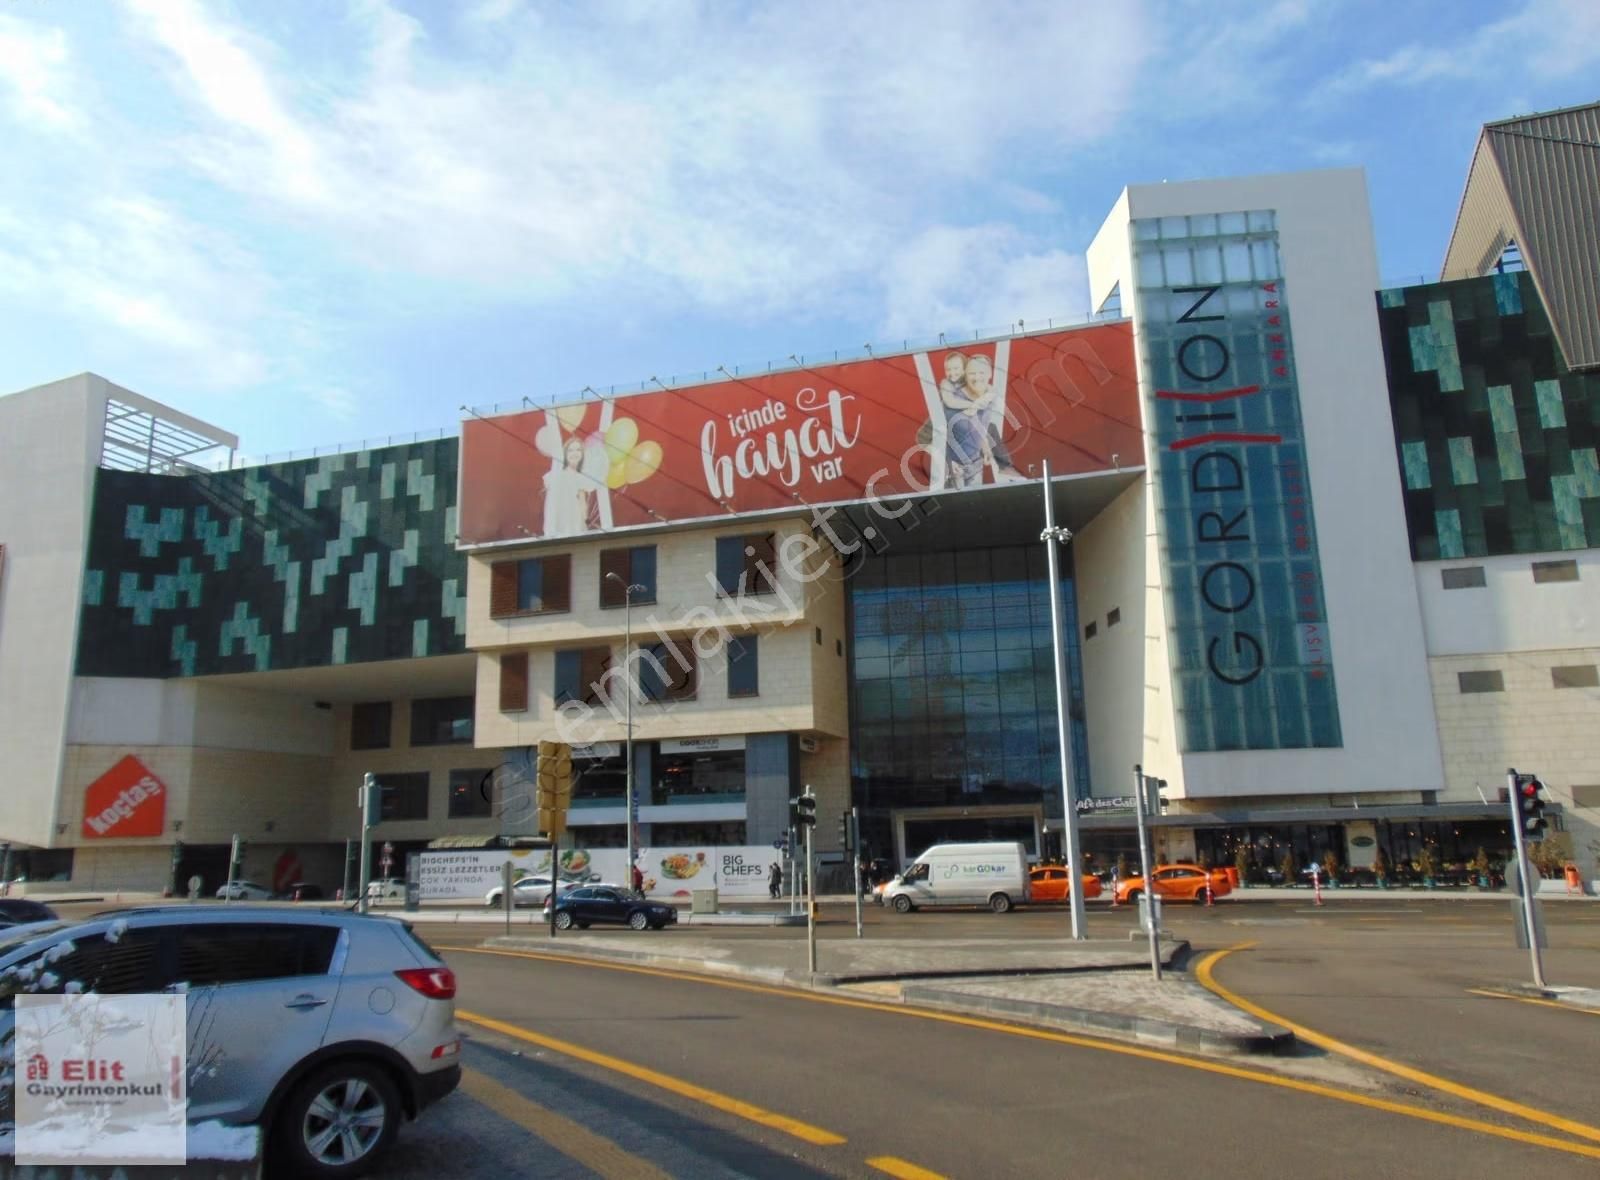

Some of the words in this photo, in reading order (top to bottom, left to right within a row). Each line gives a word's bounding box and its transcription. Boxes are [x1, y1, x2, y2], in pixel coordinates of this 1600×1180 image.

[727, 399, 787, 438] içinde
[701, 388, 861, 498] hayat
[810, 456, 843, 483] var
[84, 776, 161, 834] koçtaş
[723, 855, 744, 865] BIG
[723, 865, 762, 876] CHEFS
